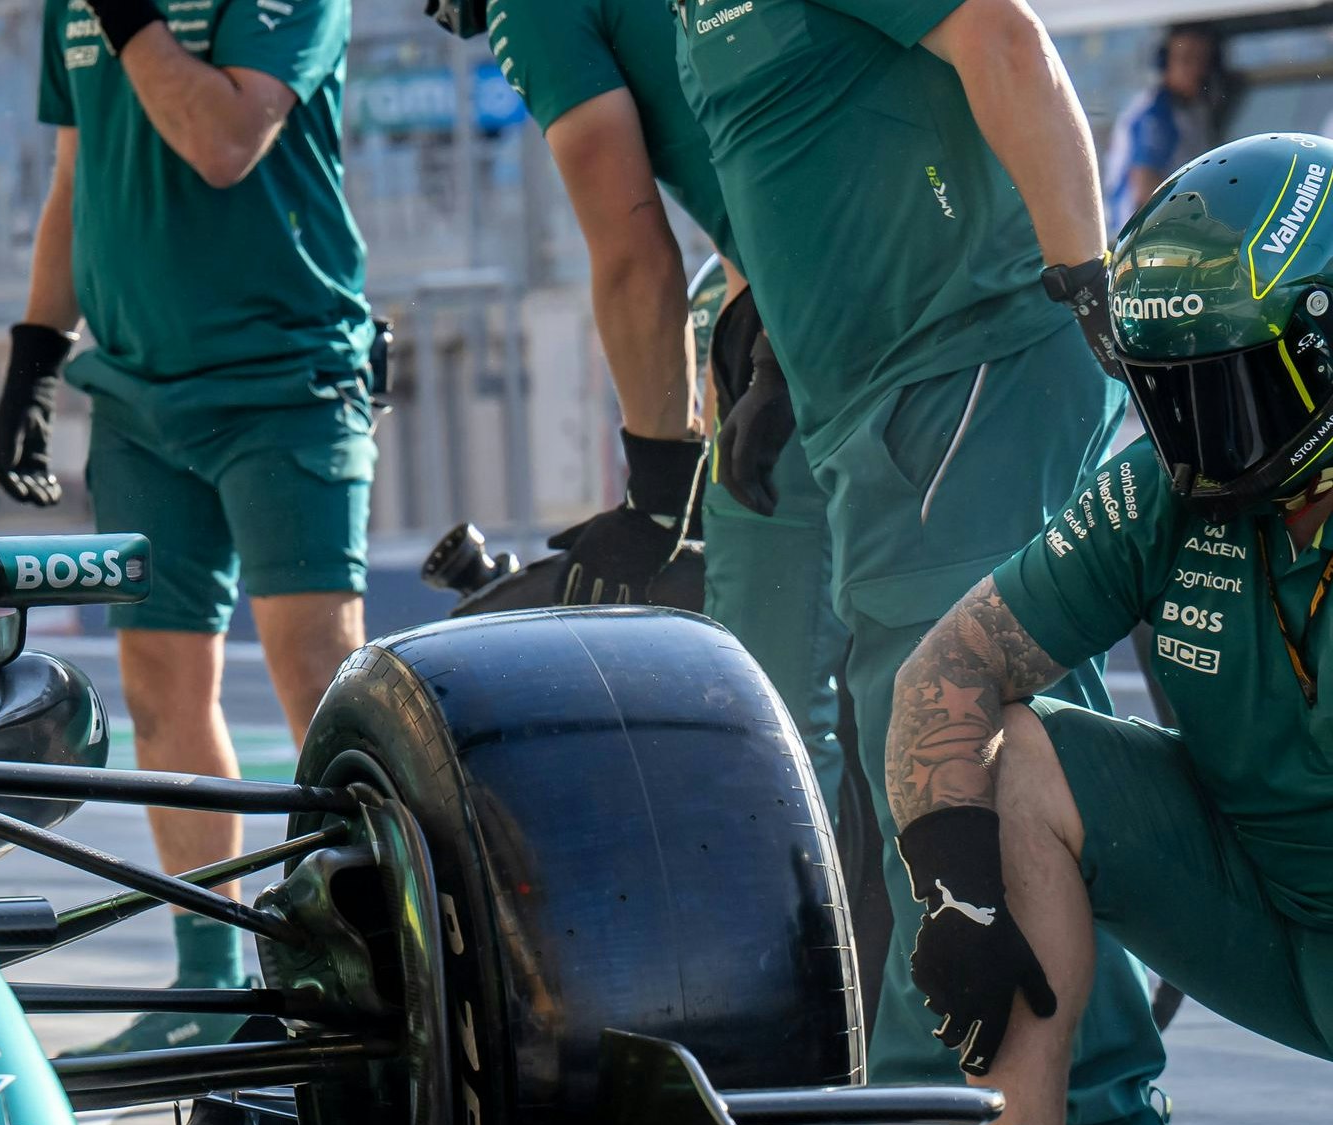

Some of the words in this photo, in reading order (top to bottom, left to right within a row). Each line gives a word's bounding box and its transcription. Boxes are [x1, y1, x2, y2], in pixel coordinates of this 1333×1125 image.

[696, 1, 753, 35] CoreWeave
[1261, 163, 1326, 254] Valvoline
[1112, 293, 1204, 319] aramco
[1290, 435, 1320, 466] ASTON
[1098, 478, 1121, 530] NexGen
[1120, 462, 1138, 519] coinbase
[1082, 500, 1096, 528] CELSIUS
[15, 549, 123, 590] BOSS
[1162, 601, 1224, 633] BOSS
[1159, 637, 1217, 673] JCB
